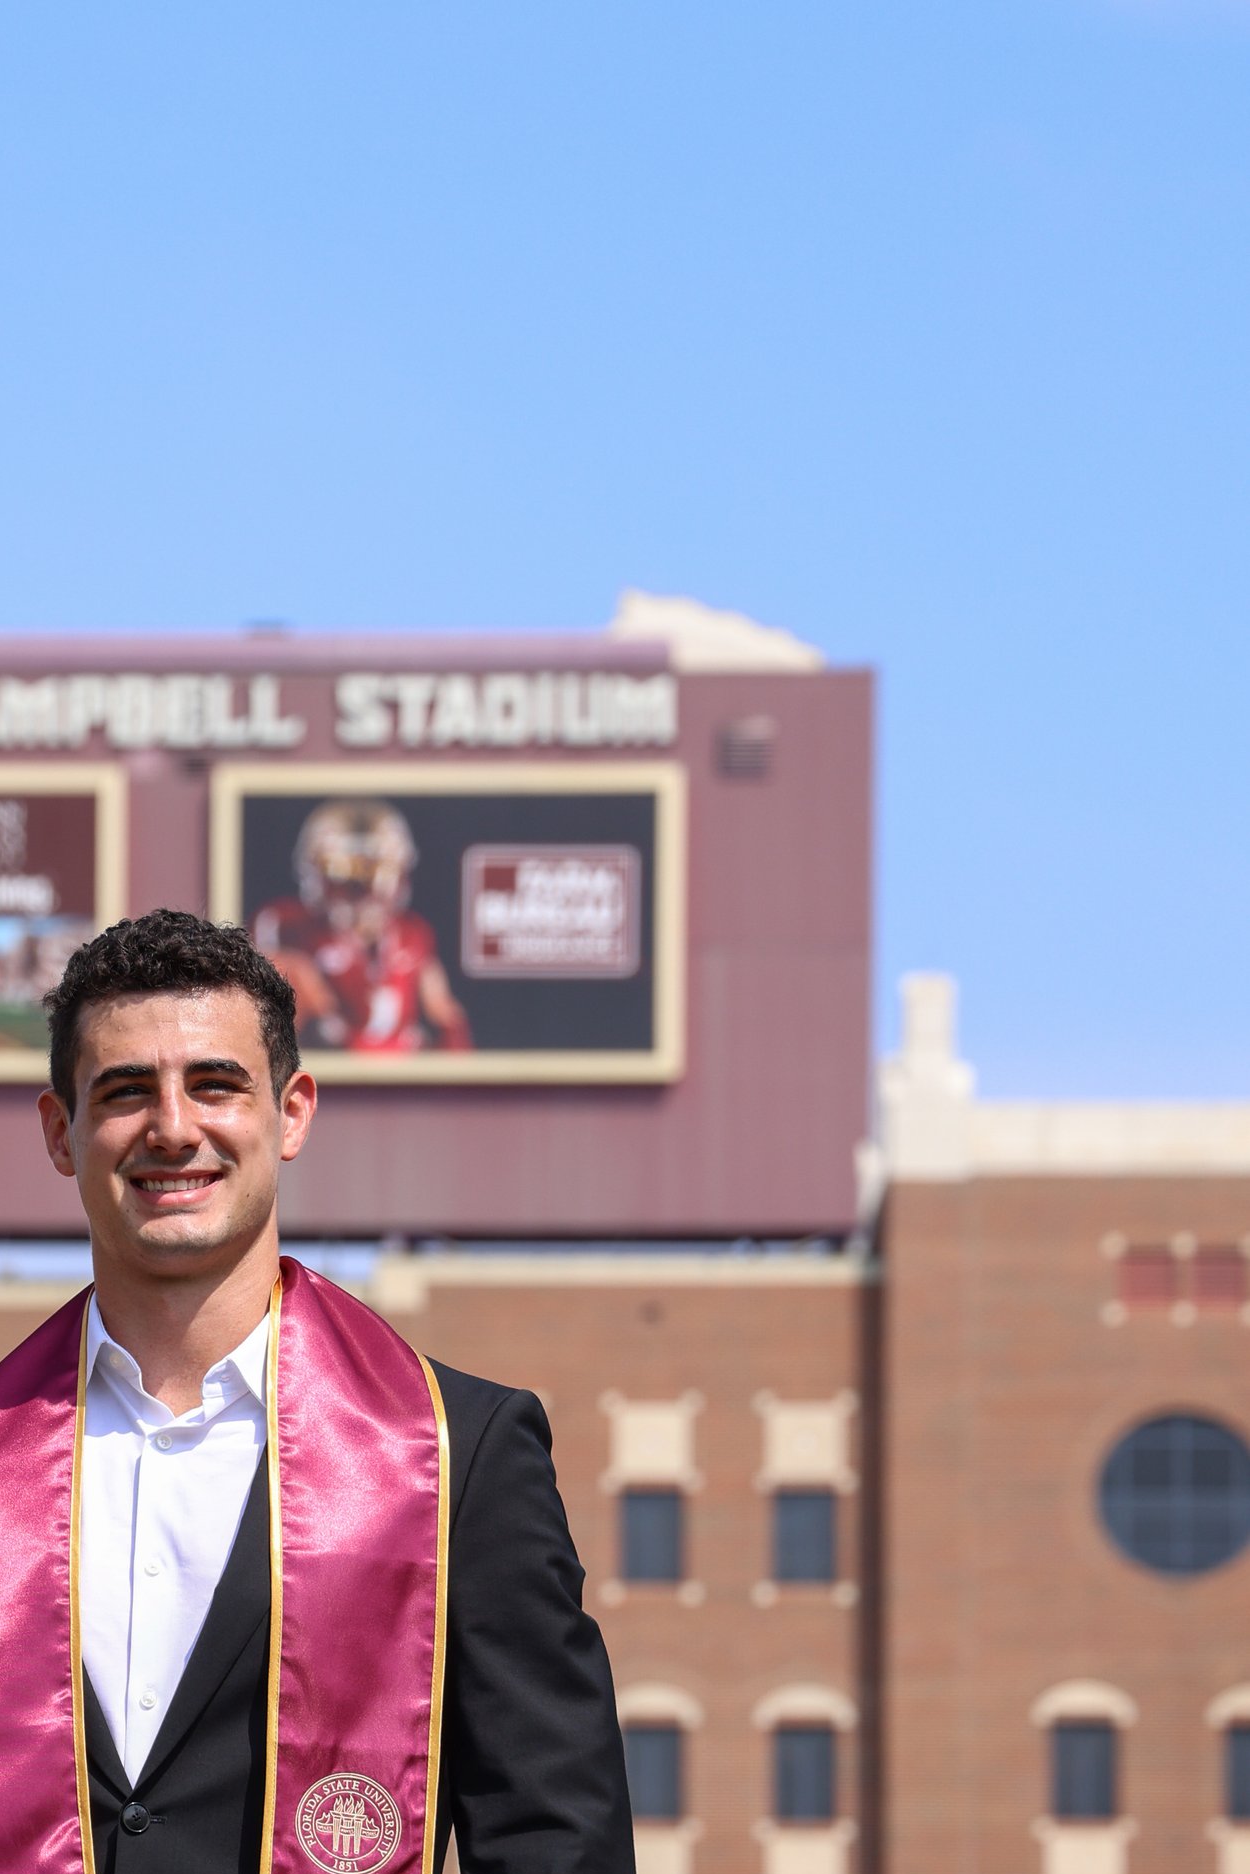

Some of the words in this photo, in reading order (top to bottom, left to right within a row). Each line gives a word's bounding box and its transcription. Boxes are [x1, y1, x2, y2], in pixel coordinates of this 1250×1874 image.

[335, 674, 677, 748] STADIUM
[302, 1793, 323, 1847] FLORIDA
[322, 1779, 361, 1795] STATE
[364, 1785, 395, 1858] UNIVERSITY
[332, 1859, 359, 1872] 1851
